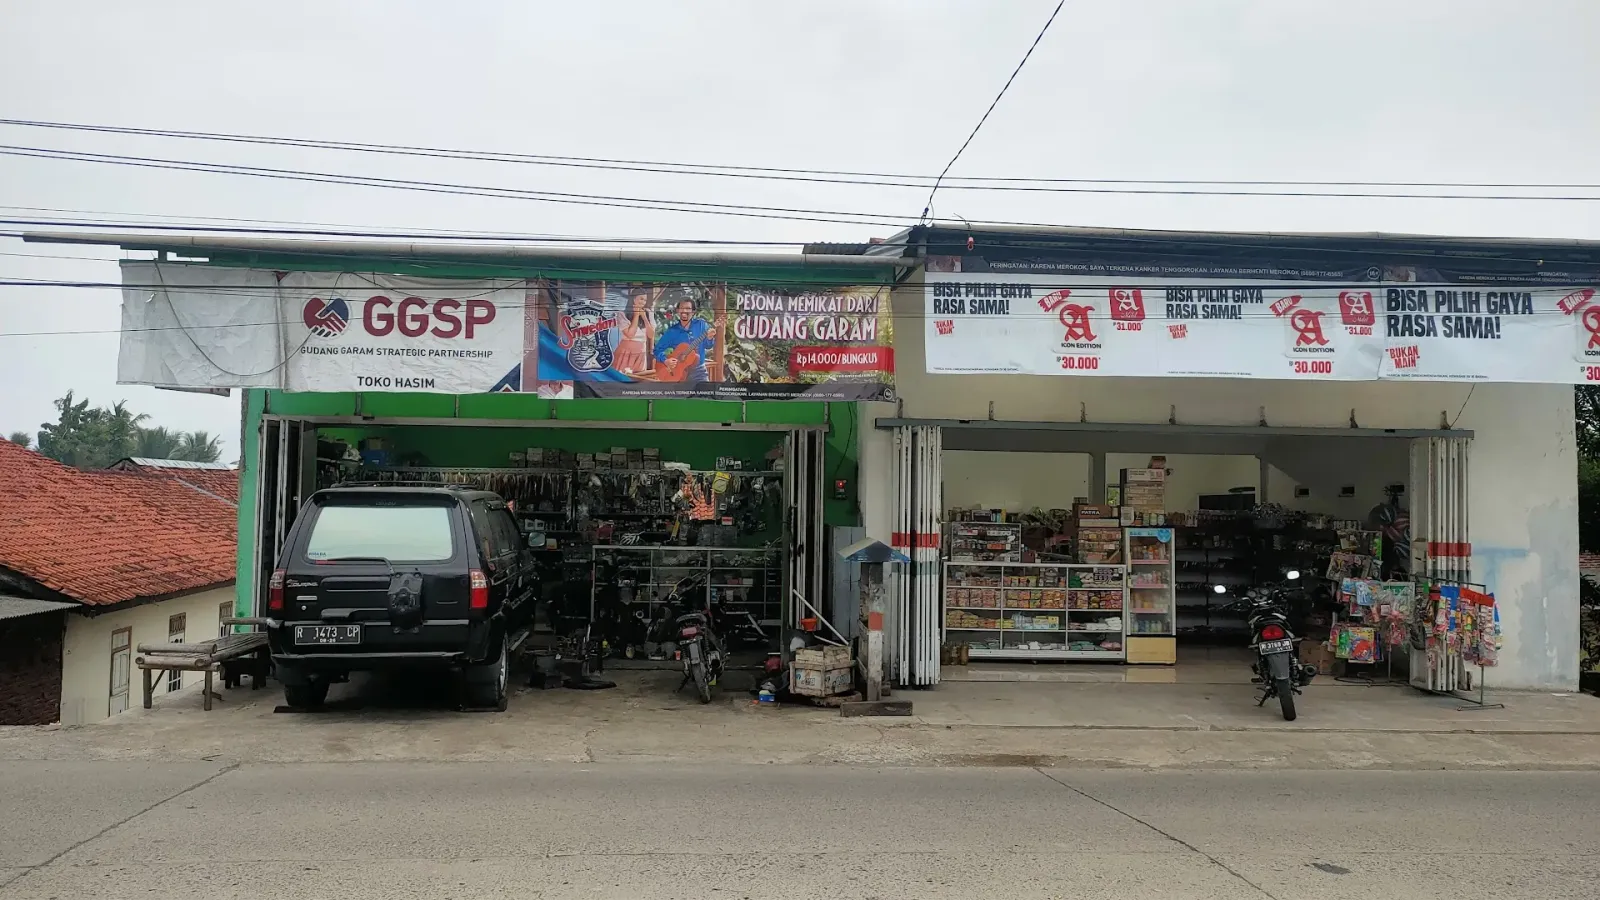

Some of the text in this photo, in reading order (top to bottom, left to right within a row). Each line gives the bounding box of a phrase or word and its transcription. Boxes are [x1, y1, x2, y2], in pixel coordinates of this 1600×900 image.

[933, 283, 1032, 299] BISA PILIH GAYA
[1166, 287, 1264, 304] BISA PILIH GAYA
[735, 294, 879, 314] PESONA MEMIKAT DARI
[933, 299, 1010, 315] RASA SAMA!
[1276, 297, 1293, 313] BARU
[1386, 289, 1534, 315] BISA PILIH GAYA
[1564, 291, 1585, 310] BARU
[363, 295, 496, 339] GGSP
[1166, 303, 1242, 320] RASA SAMA!
[733, 315, 877, 341] GUDANG GARAM
[1387, 314, 1501, 339] RASA SAMA!
[300, 346, 493, 358] GUDANG GARAM STRATEGIC PARTNERSHIP
[357, 376, 435, 389] TOKO HASIM
[297, 626, 359, 638] R 1473 CP
